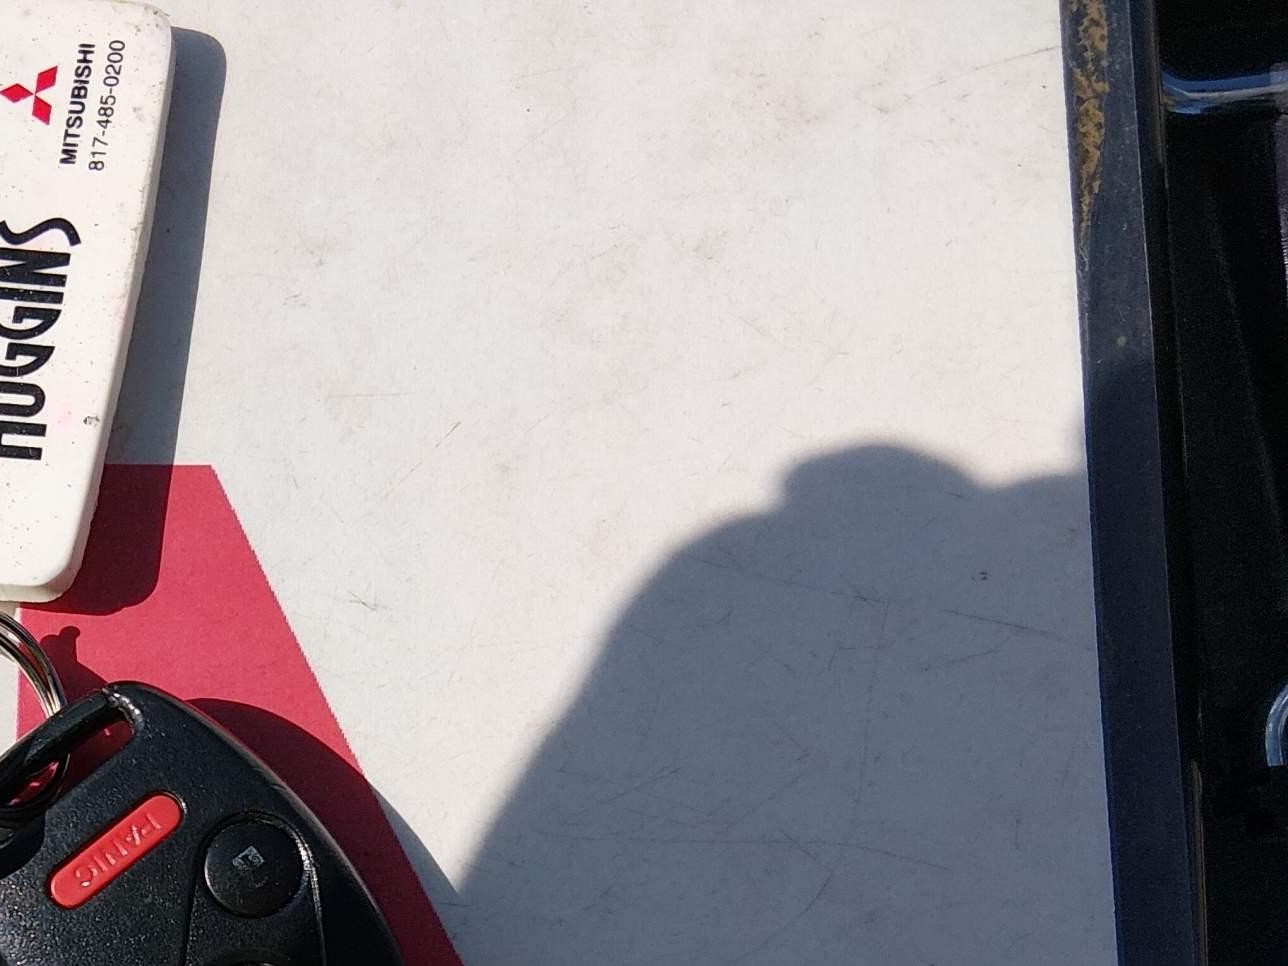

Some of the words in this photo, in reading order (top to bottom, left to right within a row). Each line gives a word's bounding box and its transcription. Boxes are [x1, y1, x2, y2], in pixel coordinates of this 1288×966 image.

[59, 43, 96, 165] MITSUBISHI
[88, 40, 126, 171] 817-485-0200
[75, 812, 162, 887] PANIC
